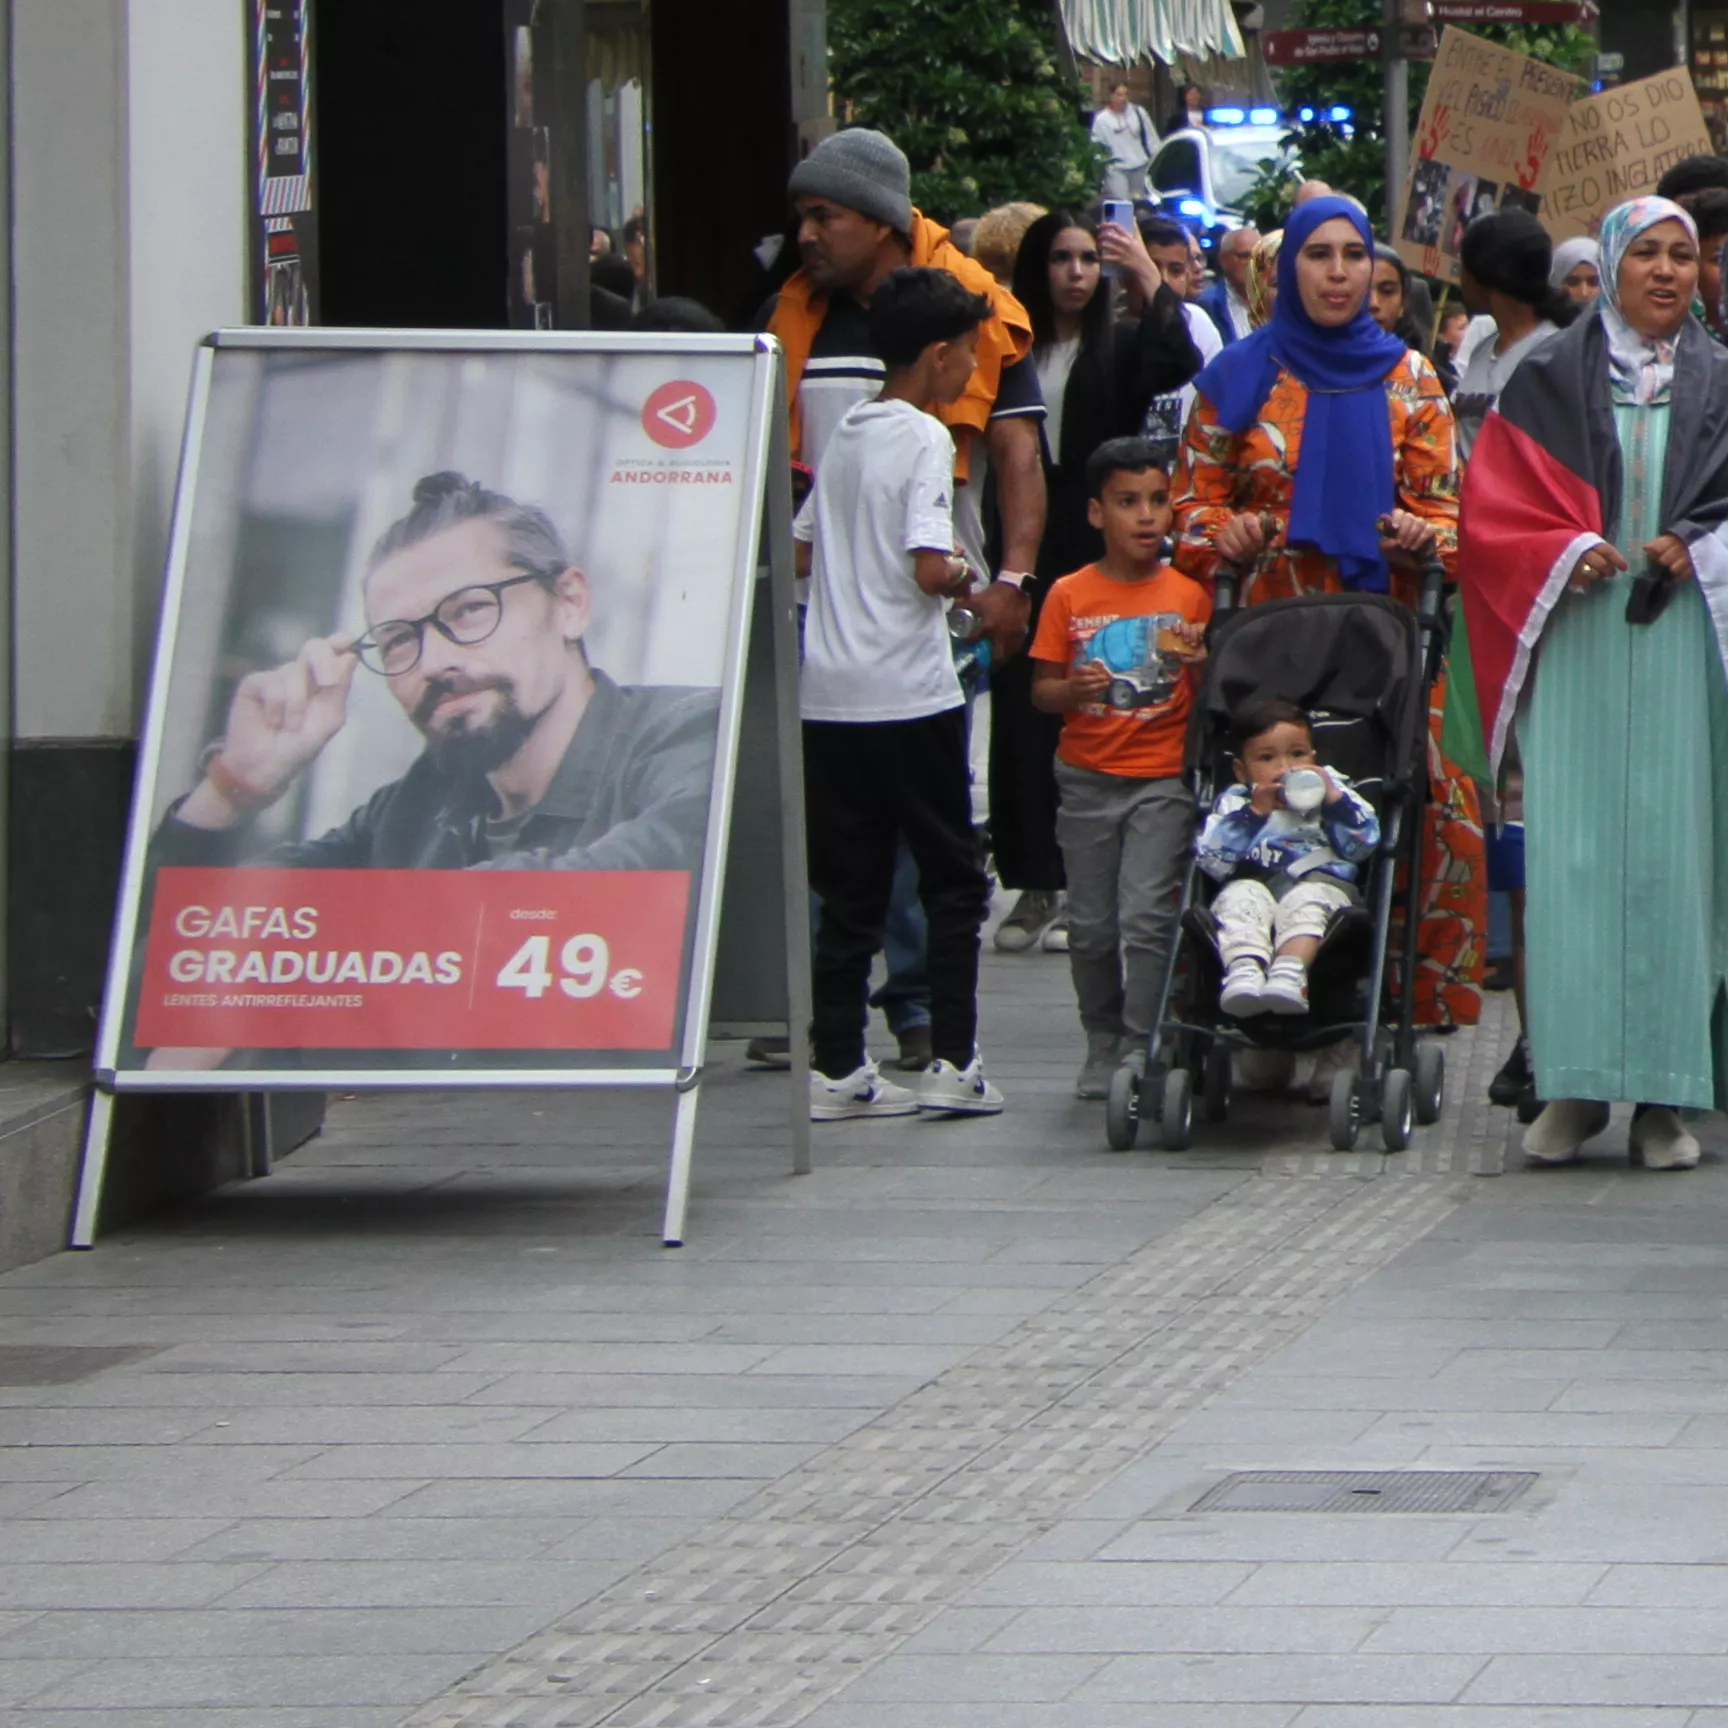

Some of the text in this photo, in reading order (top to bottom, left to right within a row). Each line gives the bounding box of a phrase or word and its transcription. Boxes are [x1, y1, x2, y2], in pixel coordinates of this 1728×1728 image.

[1569, 105, 1600, 137] NO
[1607, 91, 1640, 122] OS
[1644, 78, 1684, 109] DIO
[1556, 130, 1630, 177] TIERRA
[1635, 116, 1671, 150] LO
[609, 470, 733, 485] ANDORRANA
[175, 904, 319, 941] GAFAS
[510, 907, 558, 921] desde:
[168, 949, 463, 985] GRADUADAS
[162, 992, 363, 1007] LENTES ANTIRREFLEJANTES
